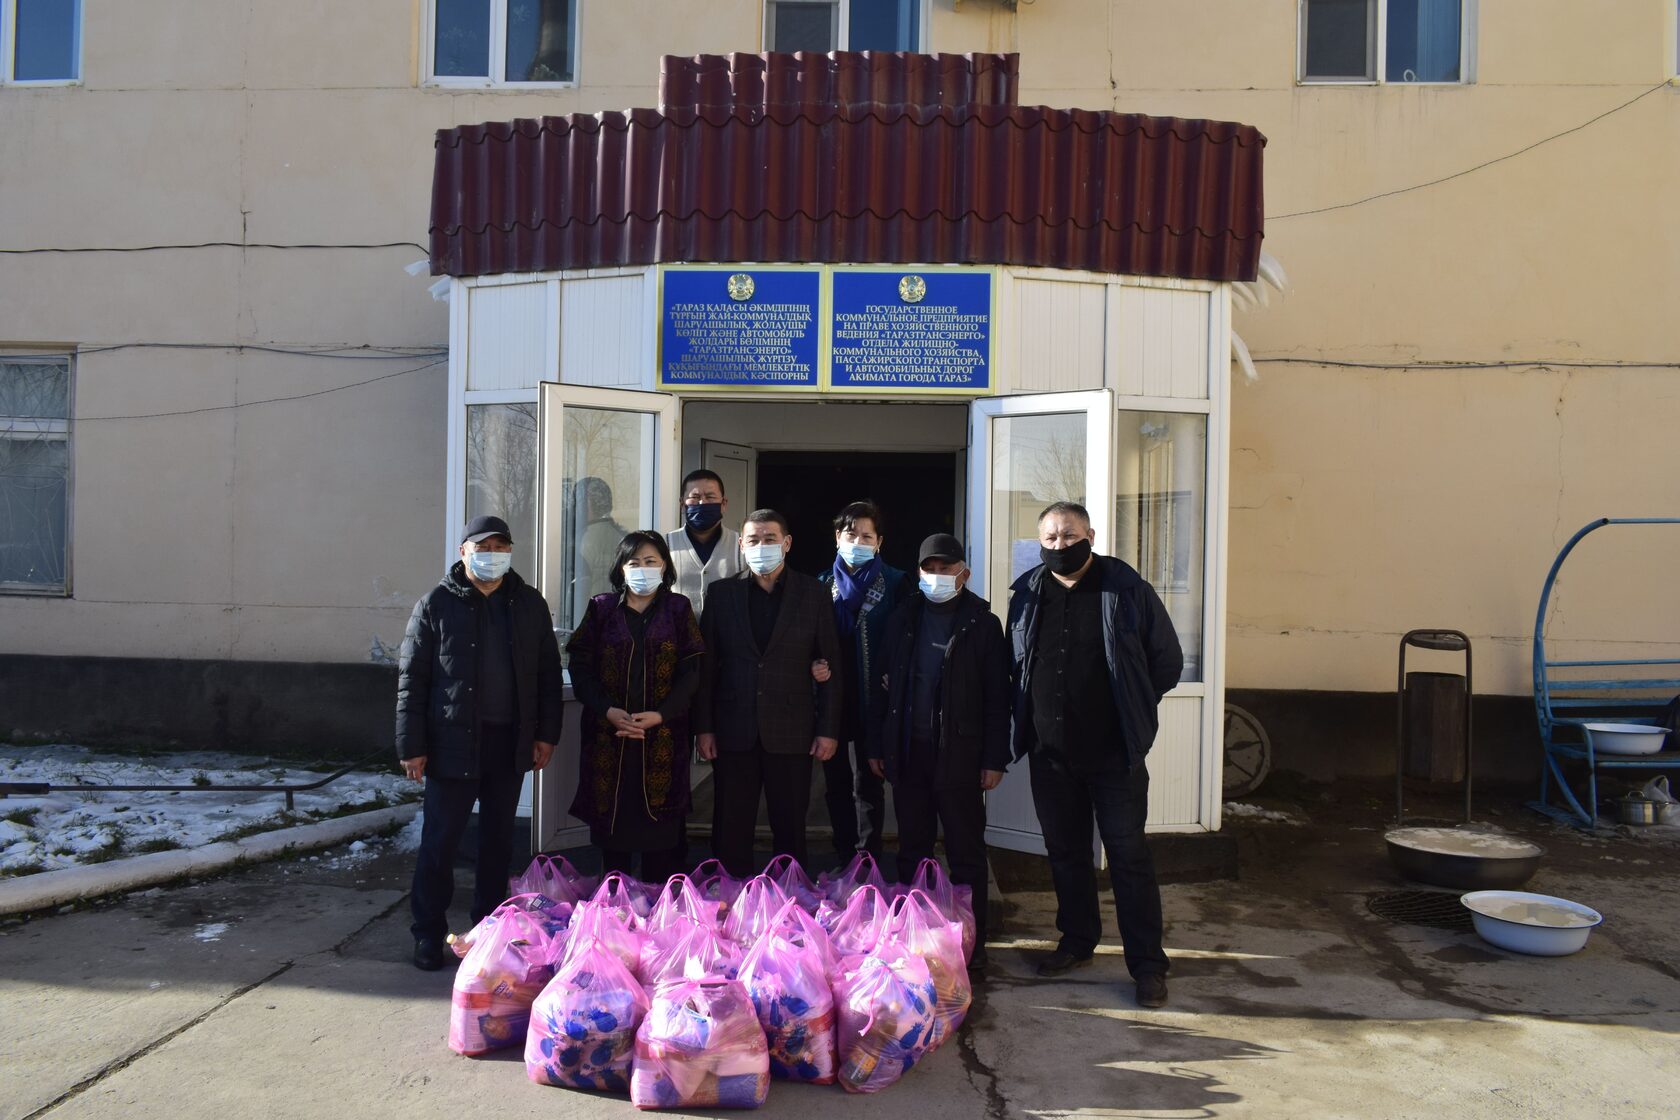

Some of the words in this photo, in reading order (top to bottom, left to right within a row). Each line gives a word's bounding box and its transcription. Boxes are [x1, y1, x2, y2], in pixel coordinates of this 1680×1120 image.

[707, 304, 747, 312] ҚАЛАСЫ
[866, 305, 957, 314] ГОСУДАРСТВЕННОЕ
[836, 314, 917, 322] КОММУНАЛЬНОЕ
[919, 315, 987, 323] ПРЕДПРИЯТИЕ
[753, 321, 806, 330] ЖОЛАУШЫ
[881, 331, 985, 340] «ТАРАЗТРАНСЭНЕРГО»
[689, 338, 737, 346] ЖОЛДАРЫ
[902, 340, 959, 348] ЖИЛИЩНО-
[834, 348, 921, 356] КОММУНАЛЬНОГО
[924, 349, 982, 358] ХОЗЯЙСТВА,
[836, 356, 921, 364] ПАССАЖИРСКОГО
[923, 357, 985, 366] ТРАНСПОРТА
[899, 374, 936, 383] ГОРОДА
